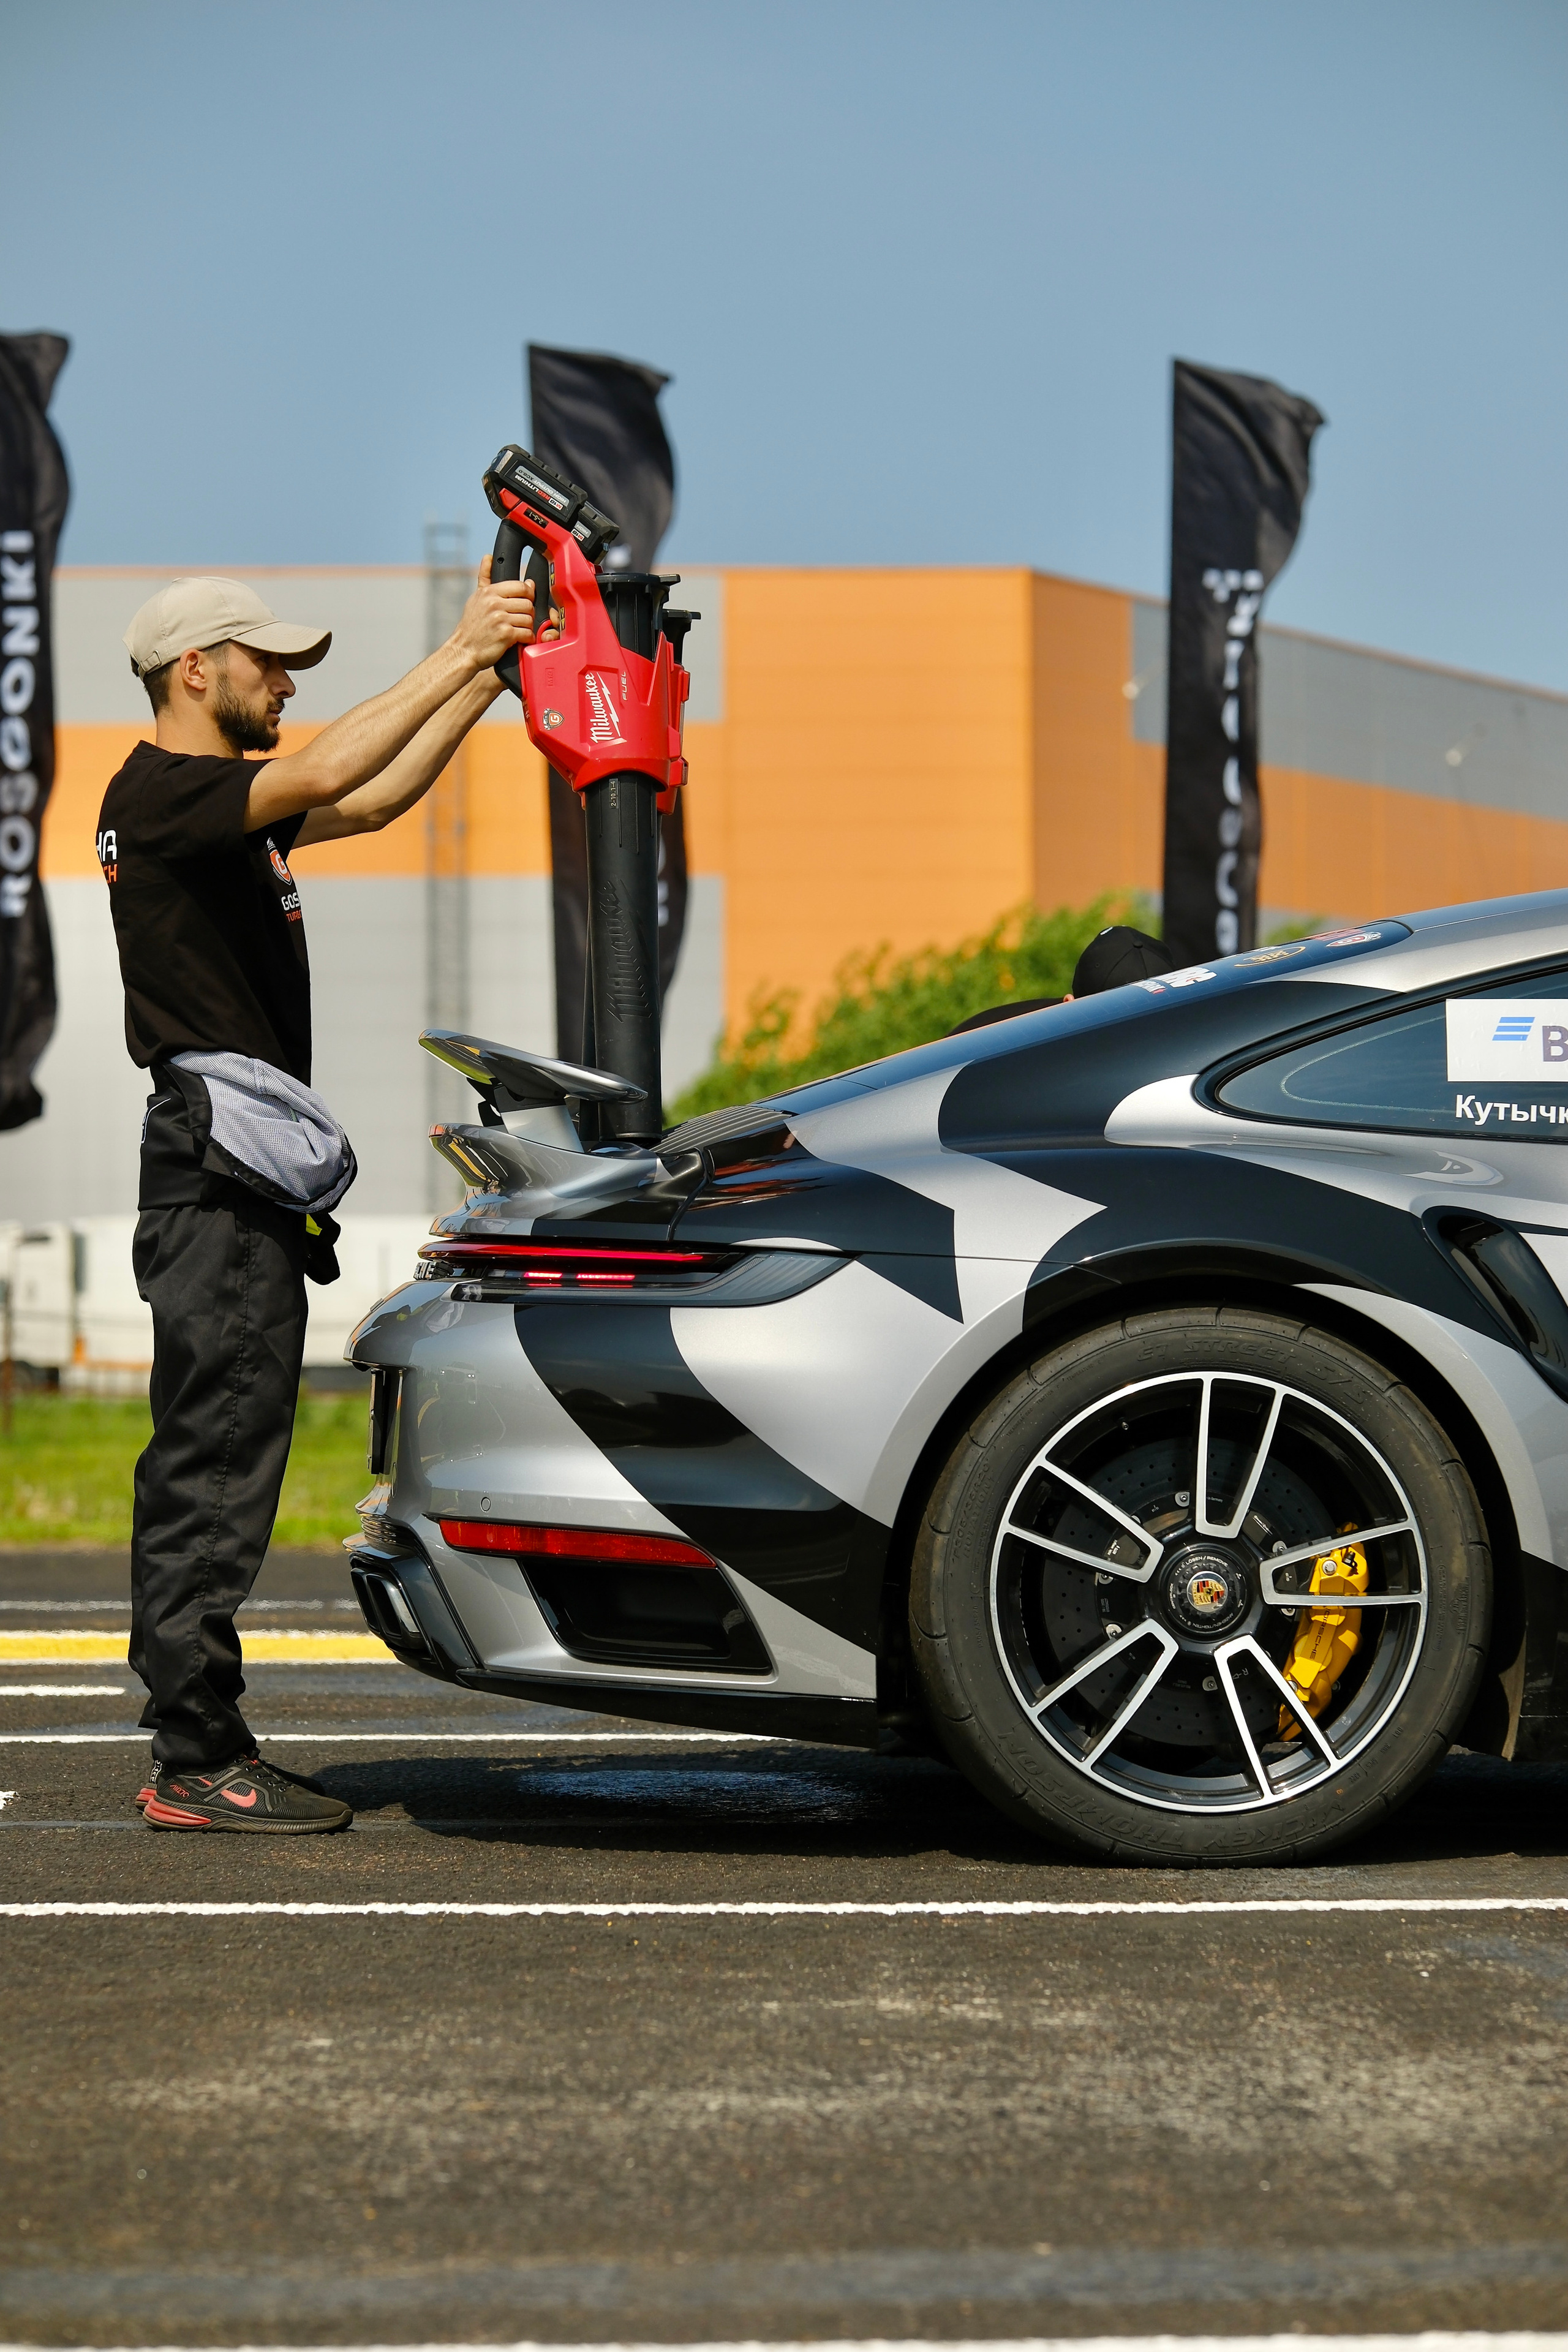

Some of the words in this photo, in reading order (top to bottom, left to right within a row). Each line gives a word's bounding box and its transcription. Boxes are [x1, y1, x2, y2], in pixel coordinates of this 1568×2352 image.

[534, 480, 553, 494] OUTPUT
[550, 499, 562, 509] M18
[553, 493, 567, 503] HIGH
[529, 511, 544, 524] 2-5-1
[572, 530, 584, 540] M18
[585, 672, 615, 744] Milwaukee
[597, 881, 652, 1023] Milwaukee
[1182, 1339, 1296, 1366] STREET
[1310, 1607, 1331, 1660] ORSCHE
[1242, 1667, 1249, 1676] R
[996, 1727, 1185, 1848] THOMPSON
[1204, 1795, 1346, 1851] MICKEY
